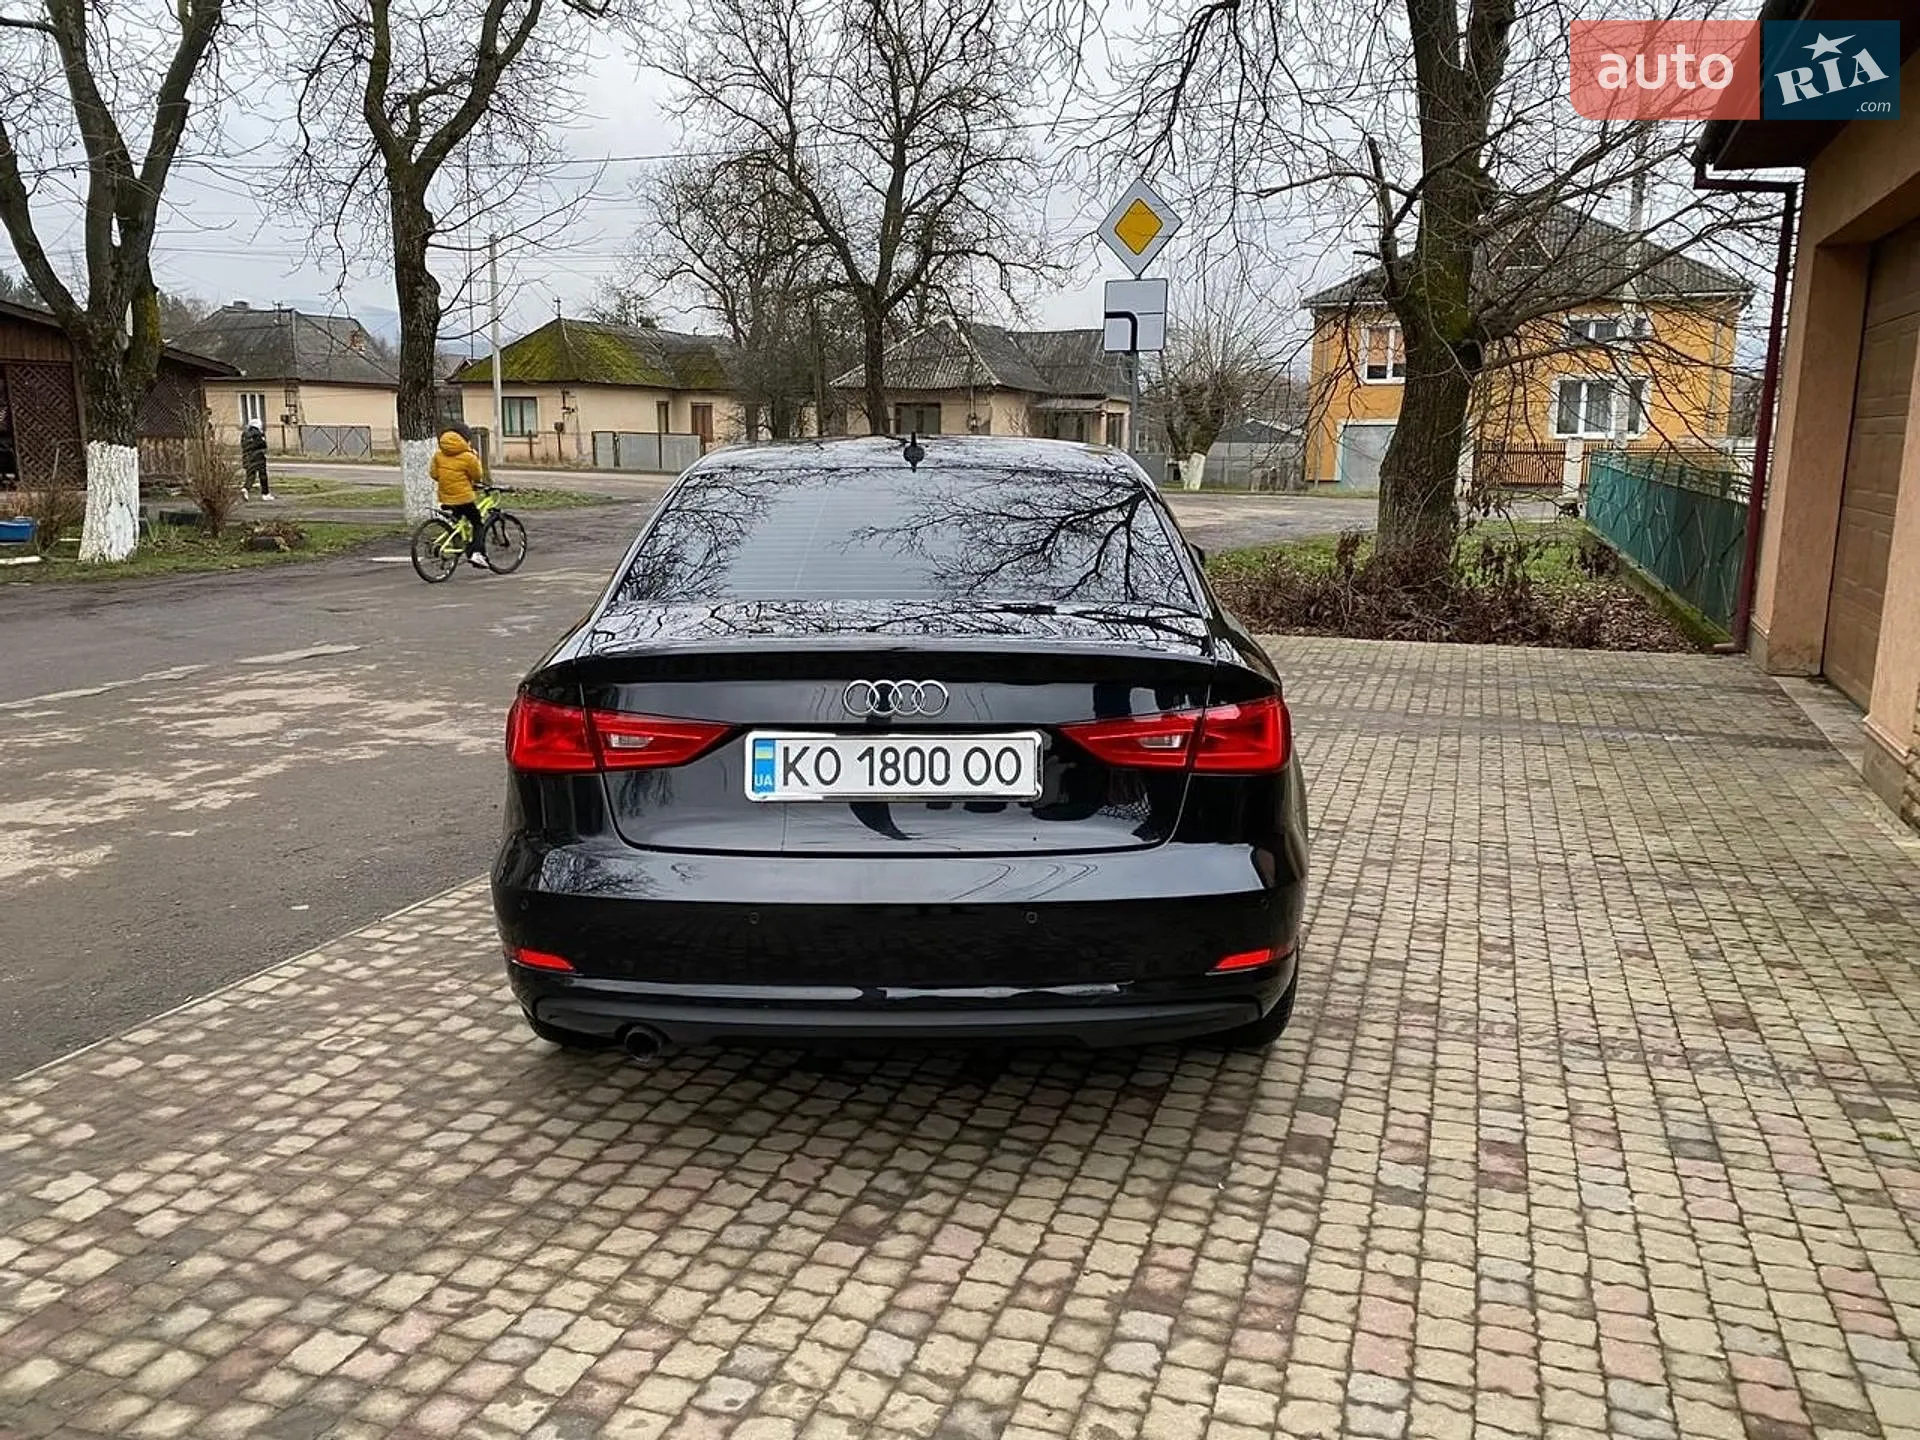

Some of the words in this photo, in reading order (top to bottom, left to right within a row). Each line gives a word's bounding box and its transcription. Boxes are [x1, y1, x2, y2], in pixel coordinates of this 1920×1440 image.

[782, 746, 842, 787] KO
[857, 746, 951, 787] 1800
[963, 746, 1022, 787] OO
[754, 774, 773, 787] UA
